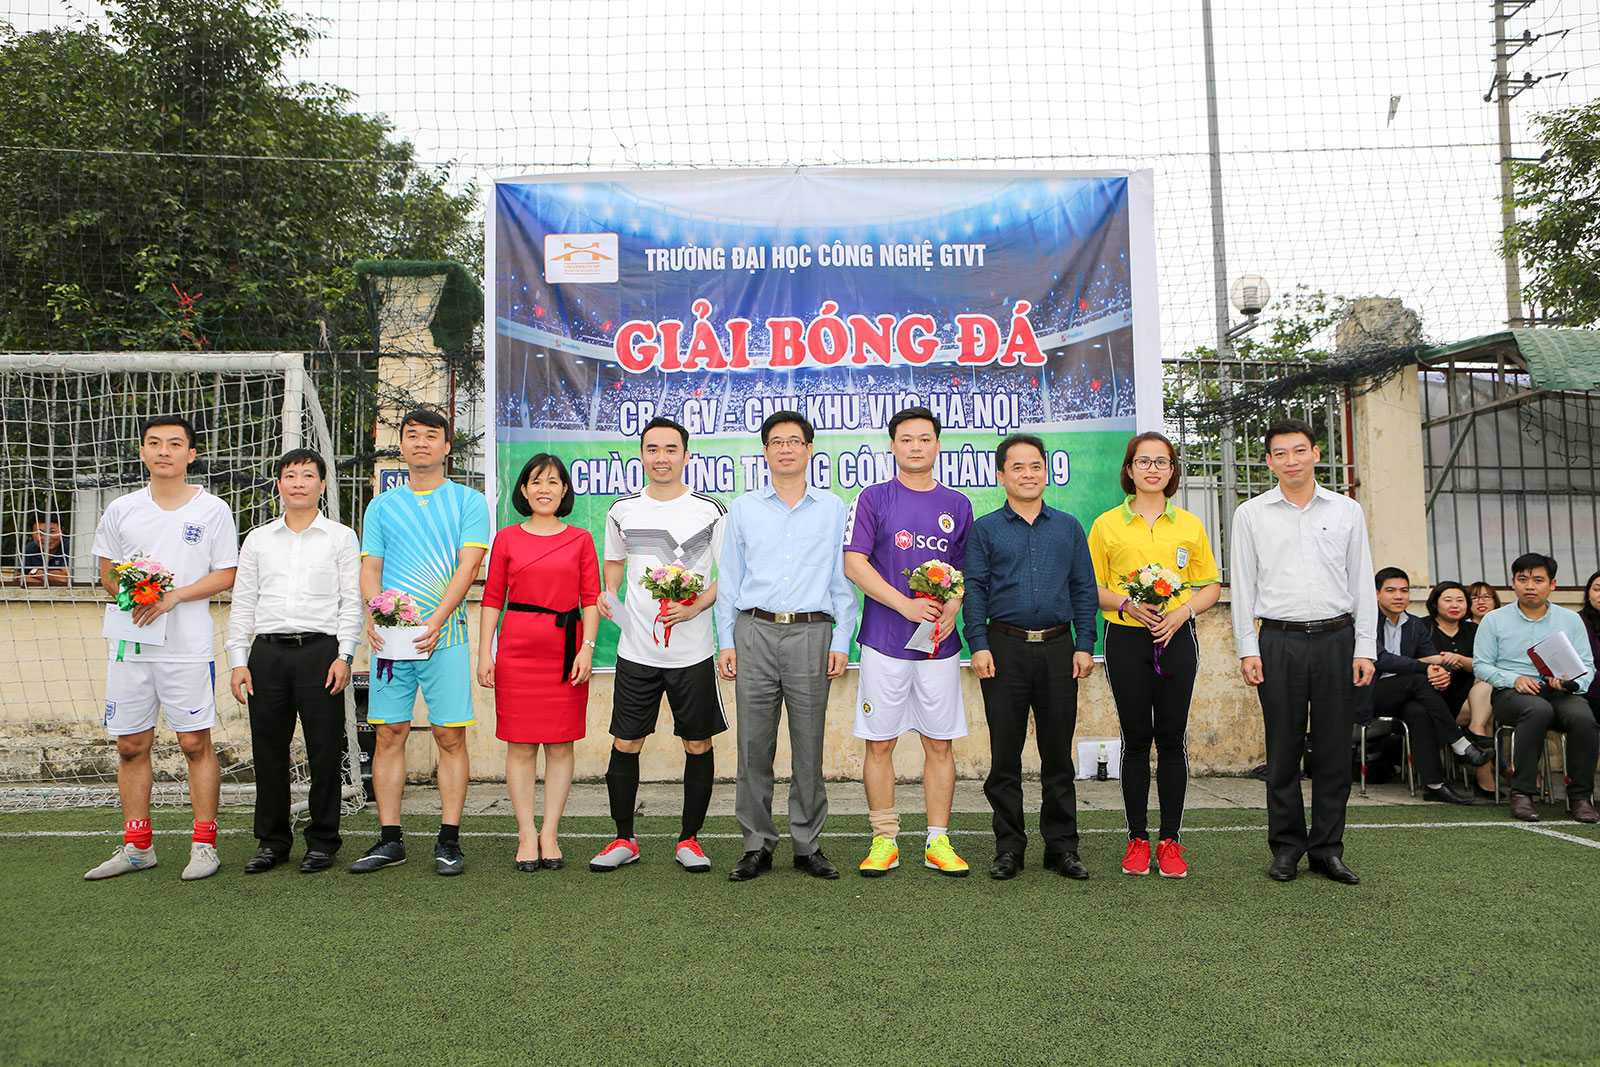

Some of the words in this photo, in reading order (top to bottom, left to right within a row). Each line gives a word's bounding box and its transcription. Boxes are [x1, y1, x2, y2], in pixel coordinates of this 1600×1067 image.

[645, 243, 726, 272] TRƯỜNG
[731, 246, 765, 274] ĐẠI
[772, 244, 812, 273] HỌC
[818, 240, 873, 267] CÔNG
[880, 240, 934, 271] NGHỆ
[940, 244, 986, 267] GTVT
[614, 298, 752, 373] GIẢI
[766, 300, 940, 367] BÓNG
[954, 299, 1047, 366] ĐÁ
[683, 398, 718, 435] GV
[806, 394, 860, 429] KHU
[929, 386, 967, 429] HÀ
[973, 387, 1020, 436] NỘI
[571, 451, 643, 496] CHÀO
[838, 445, 897, 489] CÔN
[916, 535, 949, 553] SCG
